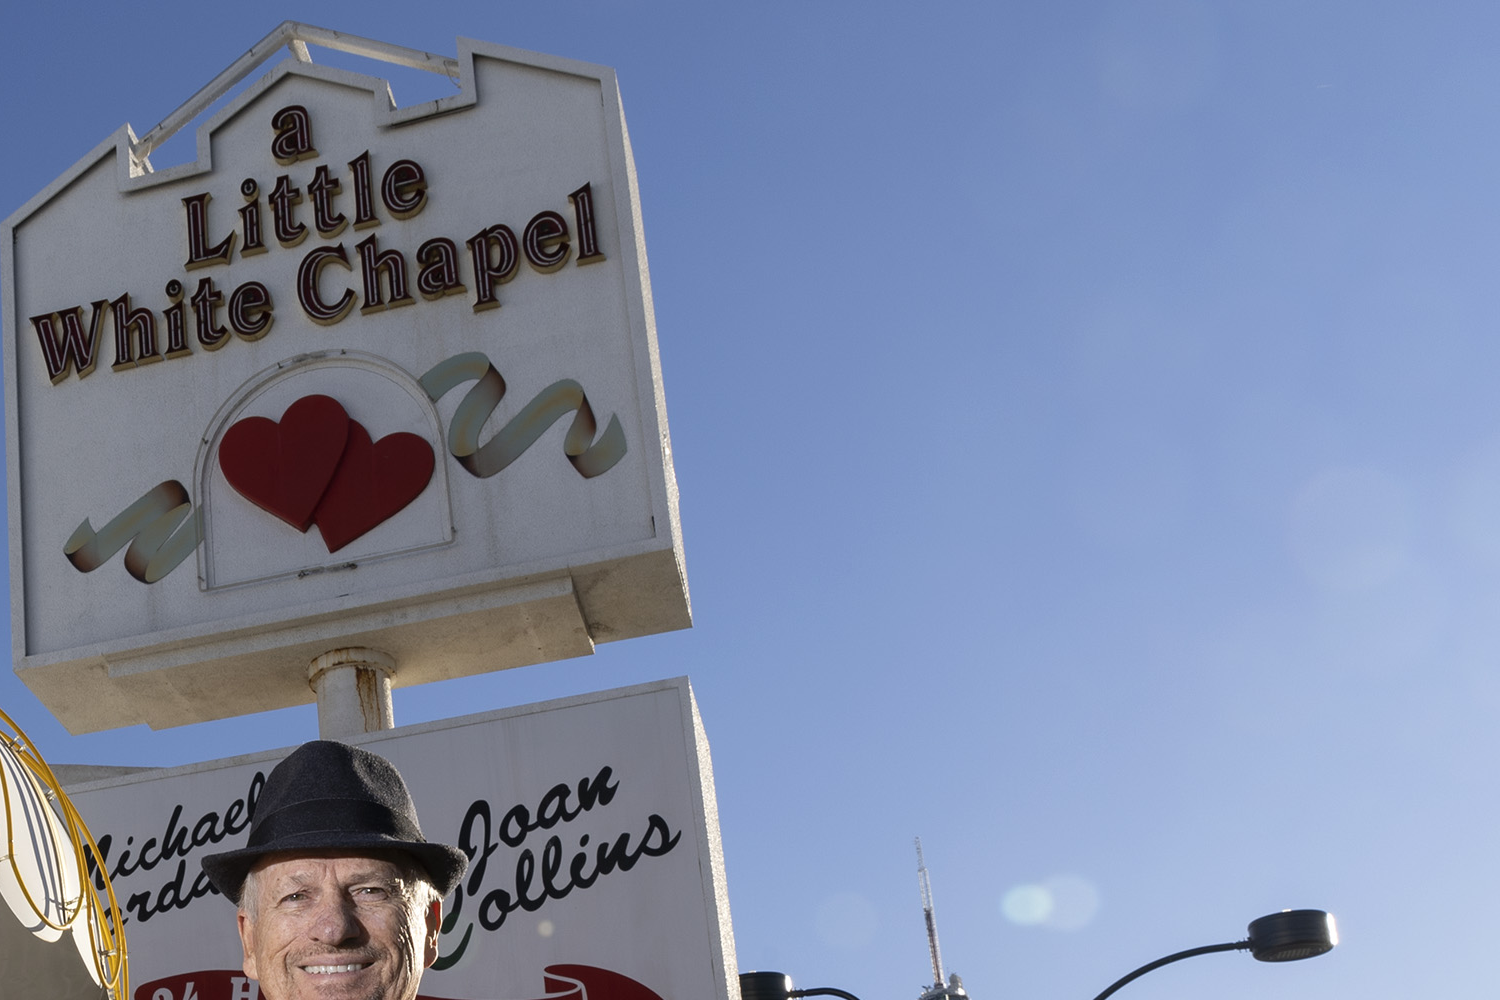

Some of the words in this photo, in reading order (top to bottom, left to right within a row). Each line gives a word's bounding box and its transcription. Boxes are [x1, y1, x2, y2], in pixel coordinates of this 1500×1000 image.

[271, 104, 318, 166] a
[182, 149, 429, 271] Little
[29, 278, 274, 386] White
[297, 181, 606, 326] Chapel
[458, 765, 621, 897] Joan
